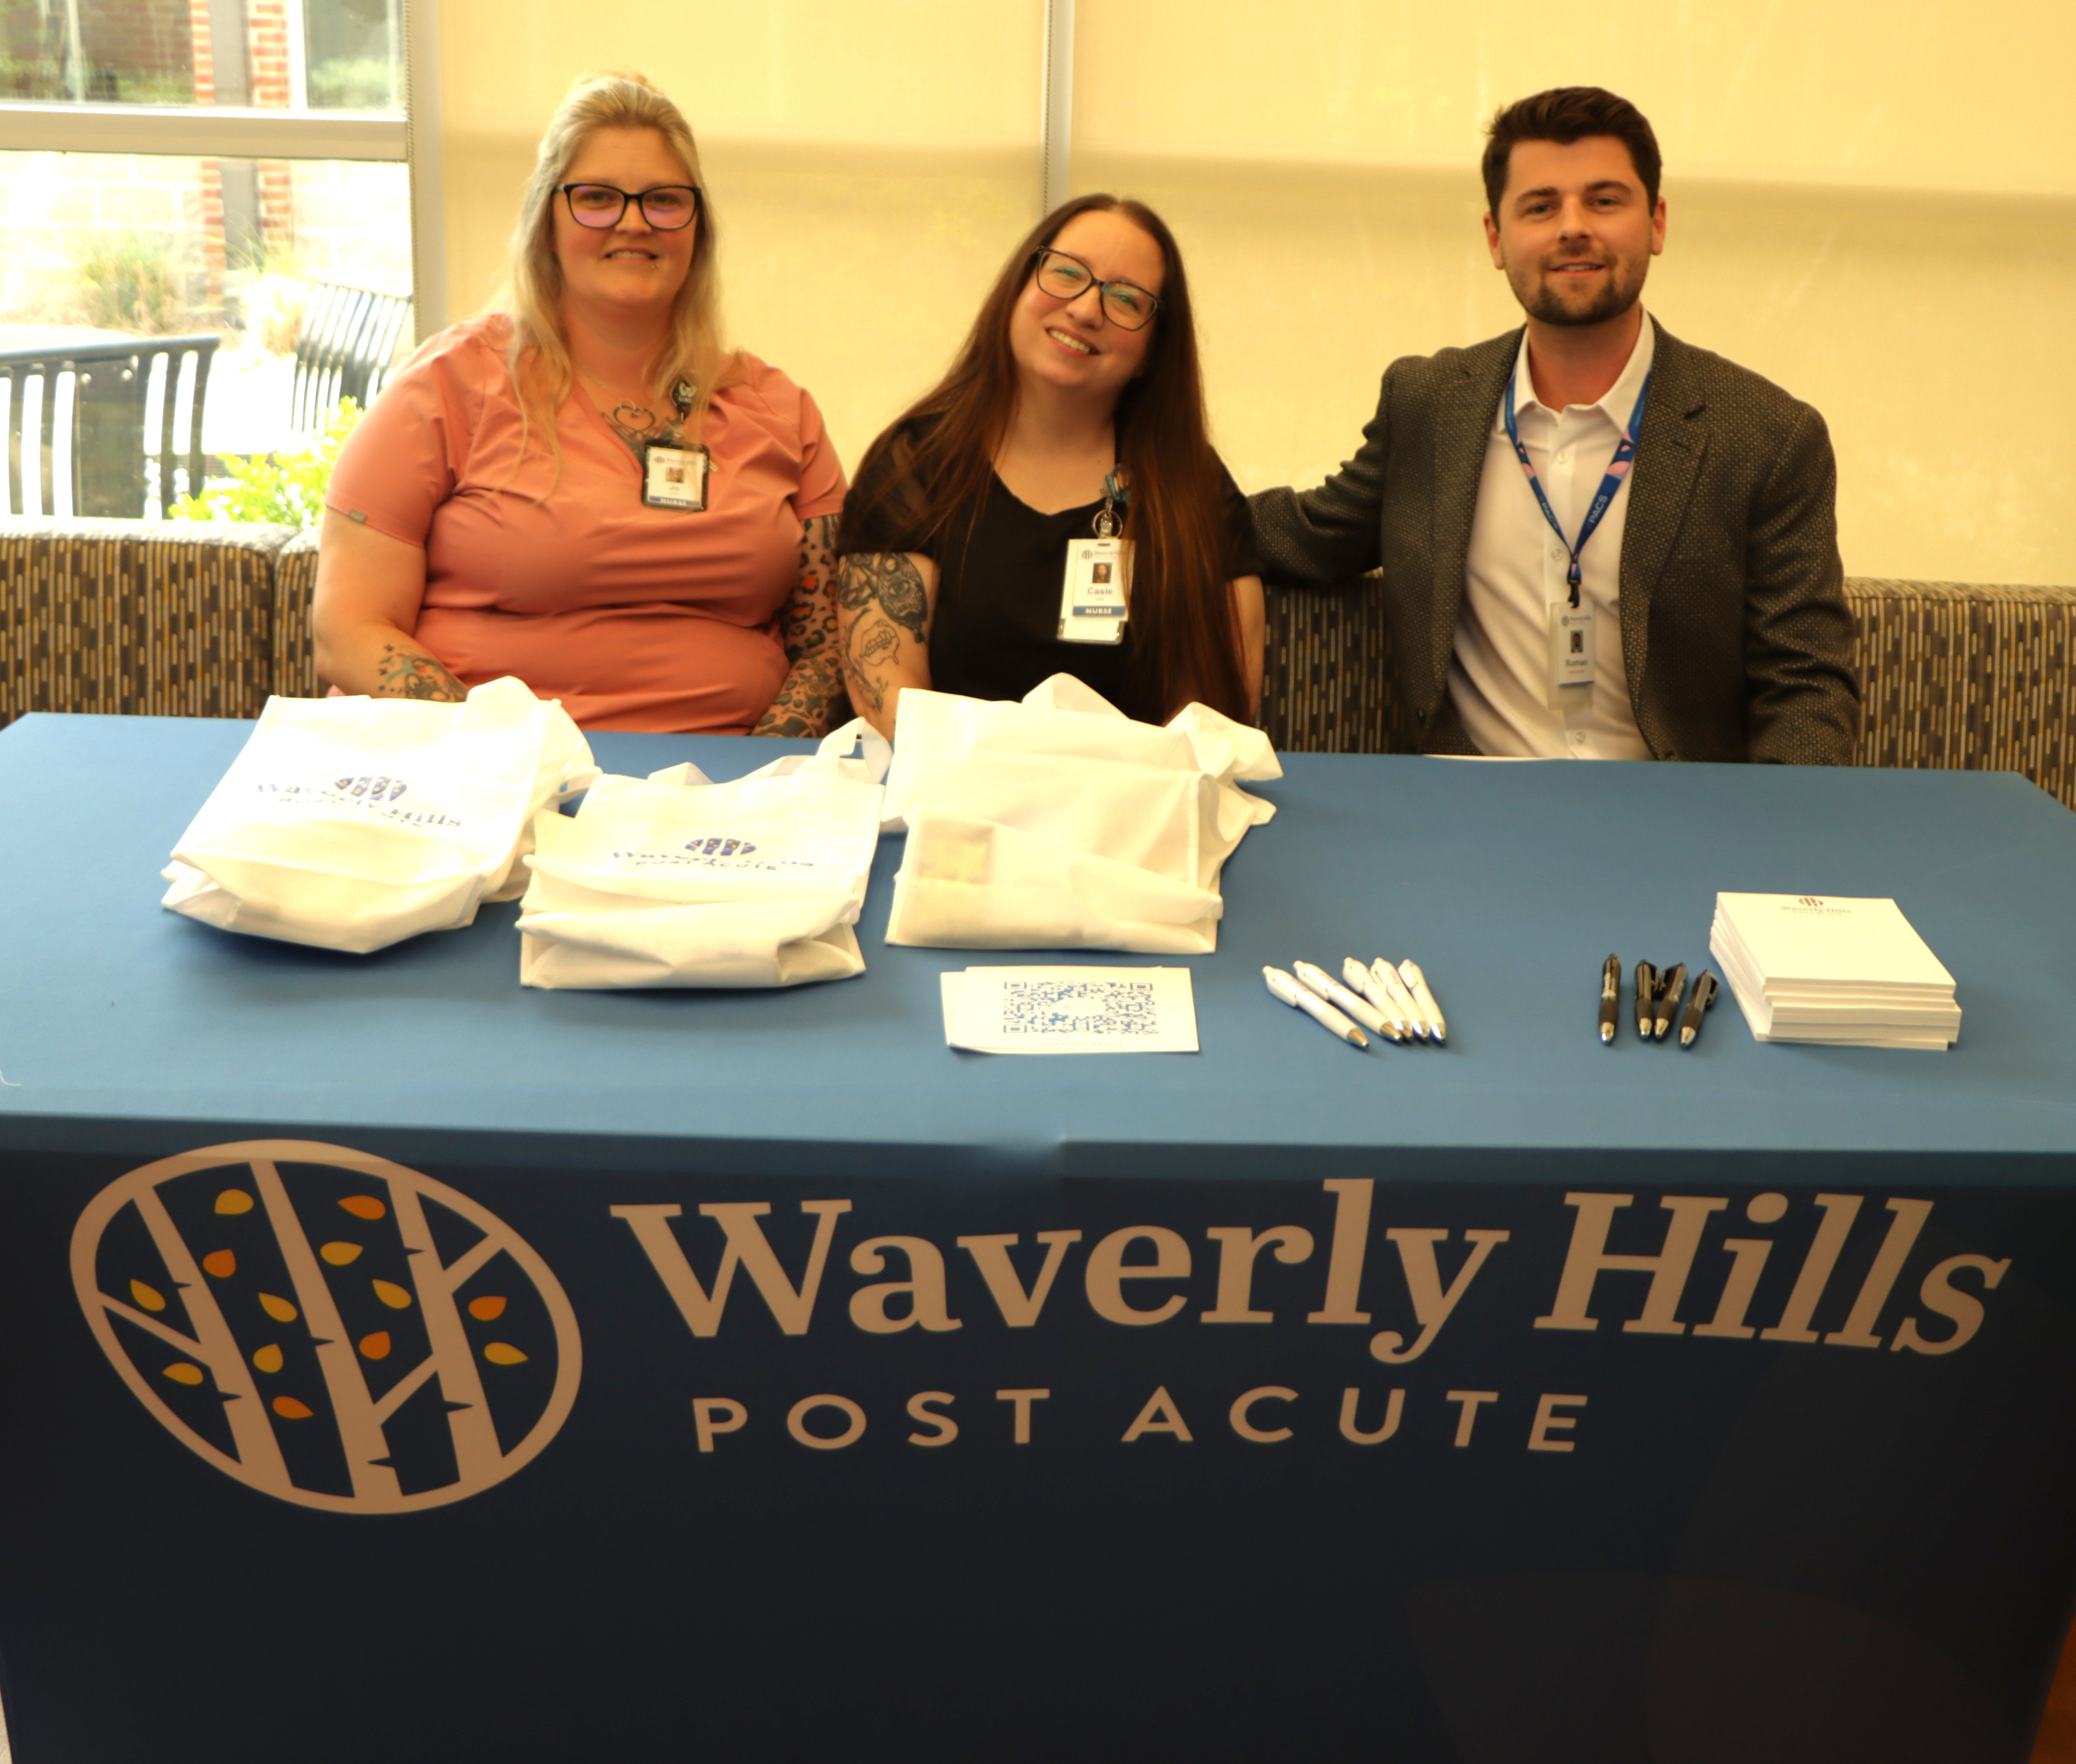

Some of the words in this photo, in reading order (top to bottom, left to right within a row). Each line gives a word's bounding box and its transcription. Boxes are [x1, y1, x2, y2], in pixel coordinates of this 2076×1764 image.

[1588, 494, 1608, 524] PACS
[391, 808, 462, 827] Hills
[610, 1178, 1510, 1363] Waverly
[1534, 1192, 2011, 1354] Hills
[693, 1388, 1050, 1452] POST
[1122, 1386, 1587, 1451] ACUTE
